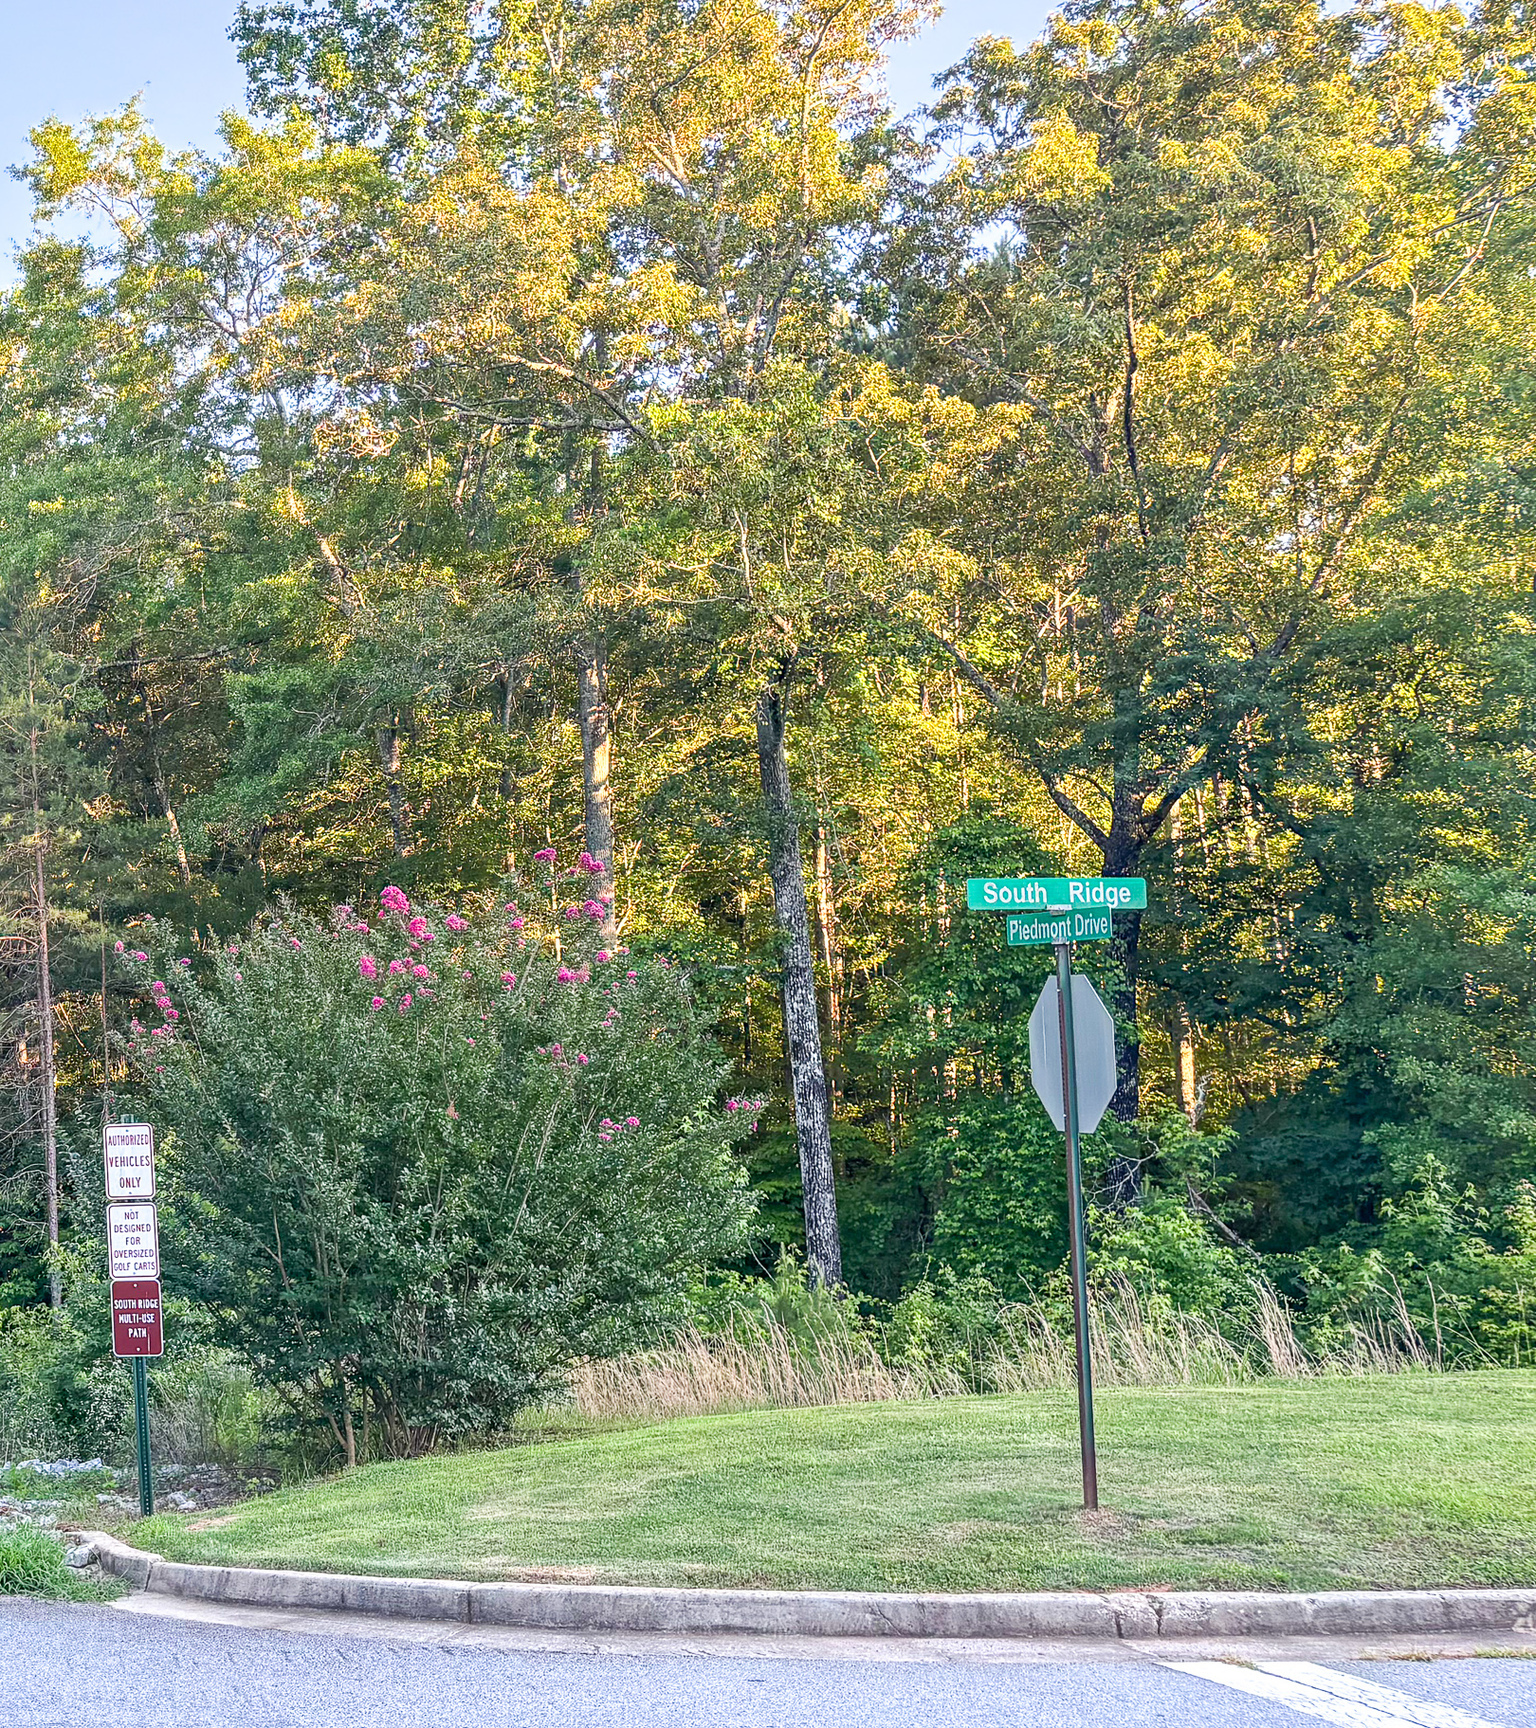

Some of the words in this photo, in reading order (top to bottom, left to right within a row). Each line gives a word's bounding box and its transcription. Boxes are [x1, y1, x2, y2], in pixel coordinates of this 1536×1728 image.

[983, 882, 1047, 904] South
[1068, 881, 1131, 908] Ridge
[1009, 914, 1071, 941] Piedmont
[1074, 911, 1108, 935] Drive
[108, 1134, 149, 1146] AUTHORIZED
[109, 1155, 150, 1167] VEHICLES
[119, 1177, 141, 1188] ONLY
[124, 1211, 139, 1220] NOT
[114, 1224, 151, 1233] DESIGNED
[126, 1237, 141, 1245] FOR
[114, 1249, 154, 1258] OVERSIZED
[114, 1262, 131, 1271] GOLF
[134, 1261, 155, 1271] CARTS
[114, 1299, 137, 1309] SOUTH
[138, 1298, 158, 1309] RIDGE
[118, 1314, 155, 1324] MULTI-USE
[128, 1327, 147, 1338] PATH
